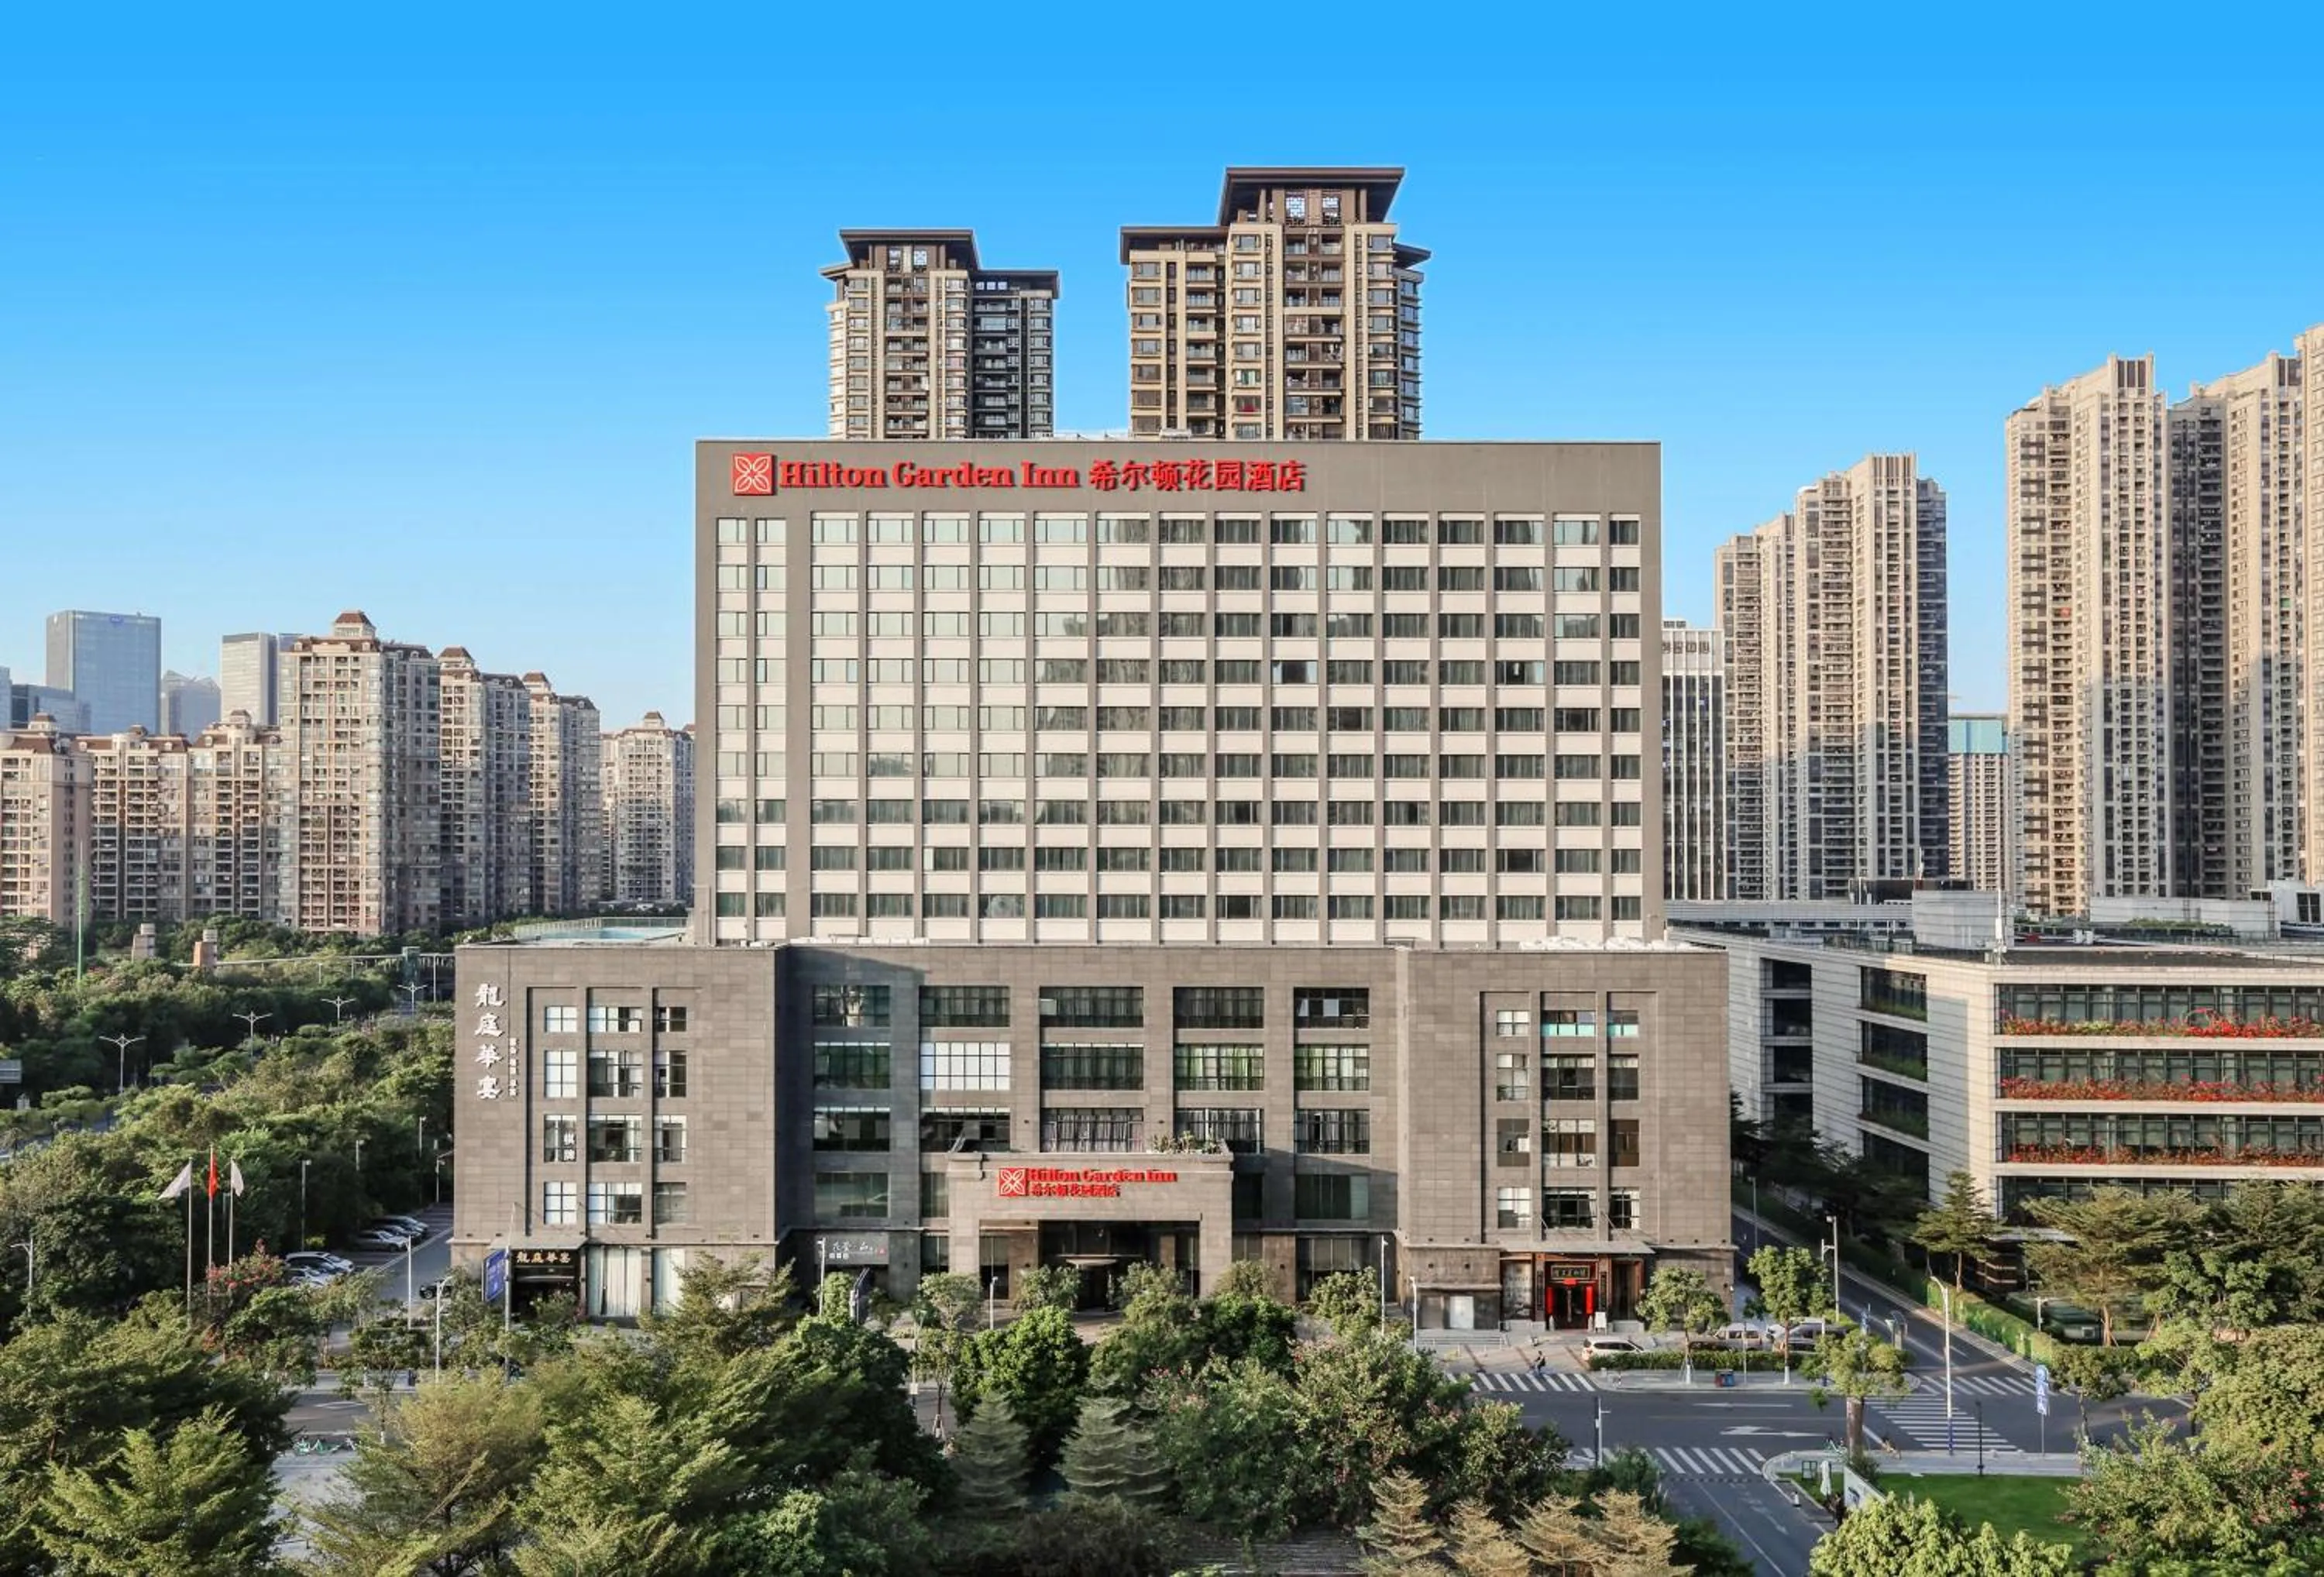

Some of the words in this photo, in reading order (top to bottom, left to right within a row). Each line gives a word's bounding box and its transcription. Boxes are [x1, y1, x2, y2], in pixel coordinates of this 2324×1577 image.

[779, 461, 886, 487] Hilton
[892, 461, 1015, 488] Garden
[1020, 462, 1079, 488] Inn
[1088, 459, 1305, 491] 希尔顿花园酒店
[1027, 1167, 1080, 1182] Hilton
[1081, 1167, 1145, 1183] Garden
[1147, 1168, 1177, 1183] Inn
